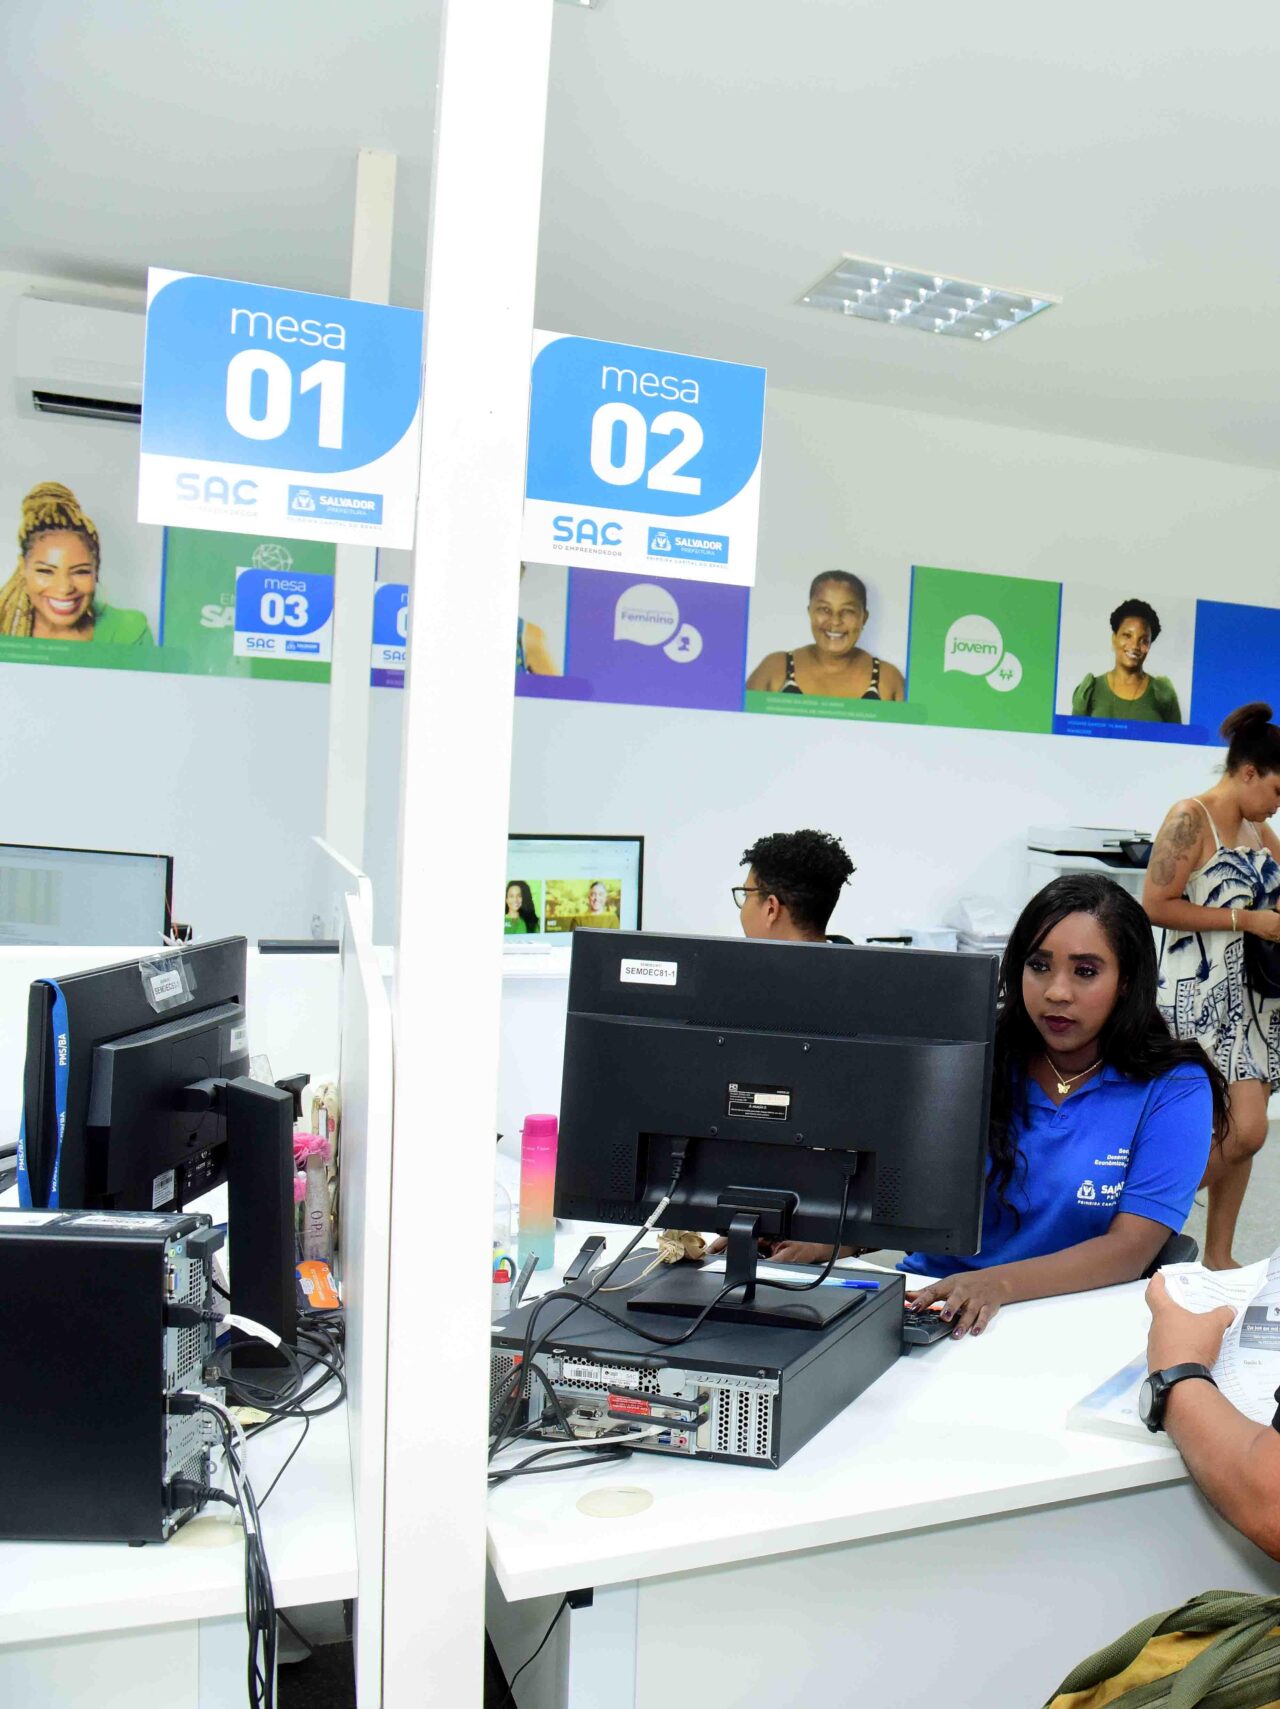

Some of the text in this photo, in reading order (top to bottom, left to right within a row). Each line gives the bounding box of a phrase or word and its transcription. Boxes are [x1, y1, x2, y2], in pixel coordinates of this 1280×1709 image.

[231, 308, 346, 350] mesa
[601, 366, 699, 404] mesa
[225, 349, 346, 449] 01
[590, 402, 704, 496] 02
[176, 473, 259, 506] SAC
[319, 495, 376, 512] SALVADOR
[553, 515, 623, 546] SAC
[565, 545, 622, 557] EMPREENDEDOR
[675, 536, 723, 551] SALVADOR
[264, 578, 306, 592] mesa
[260, 592, 309, 627] 03
[621, 611, 675, 625] Feminino
[246, 638, 275, 649] SAC
[951, 637, 997, 655] jovem
[625, 966, 675, 978] SEMDEC81-1
[58, 1033, 68, 1066] PMS/BA
